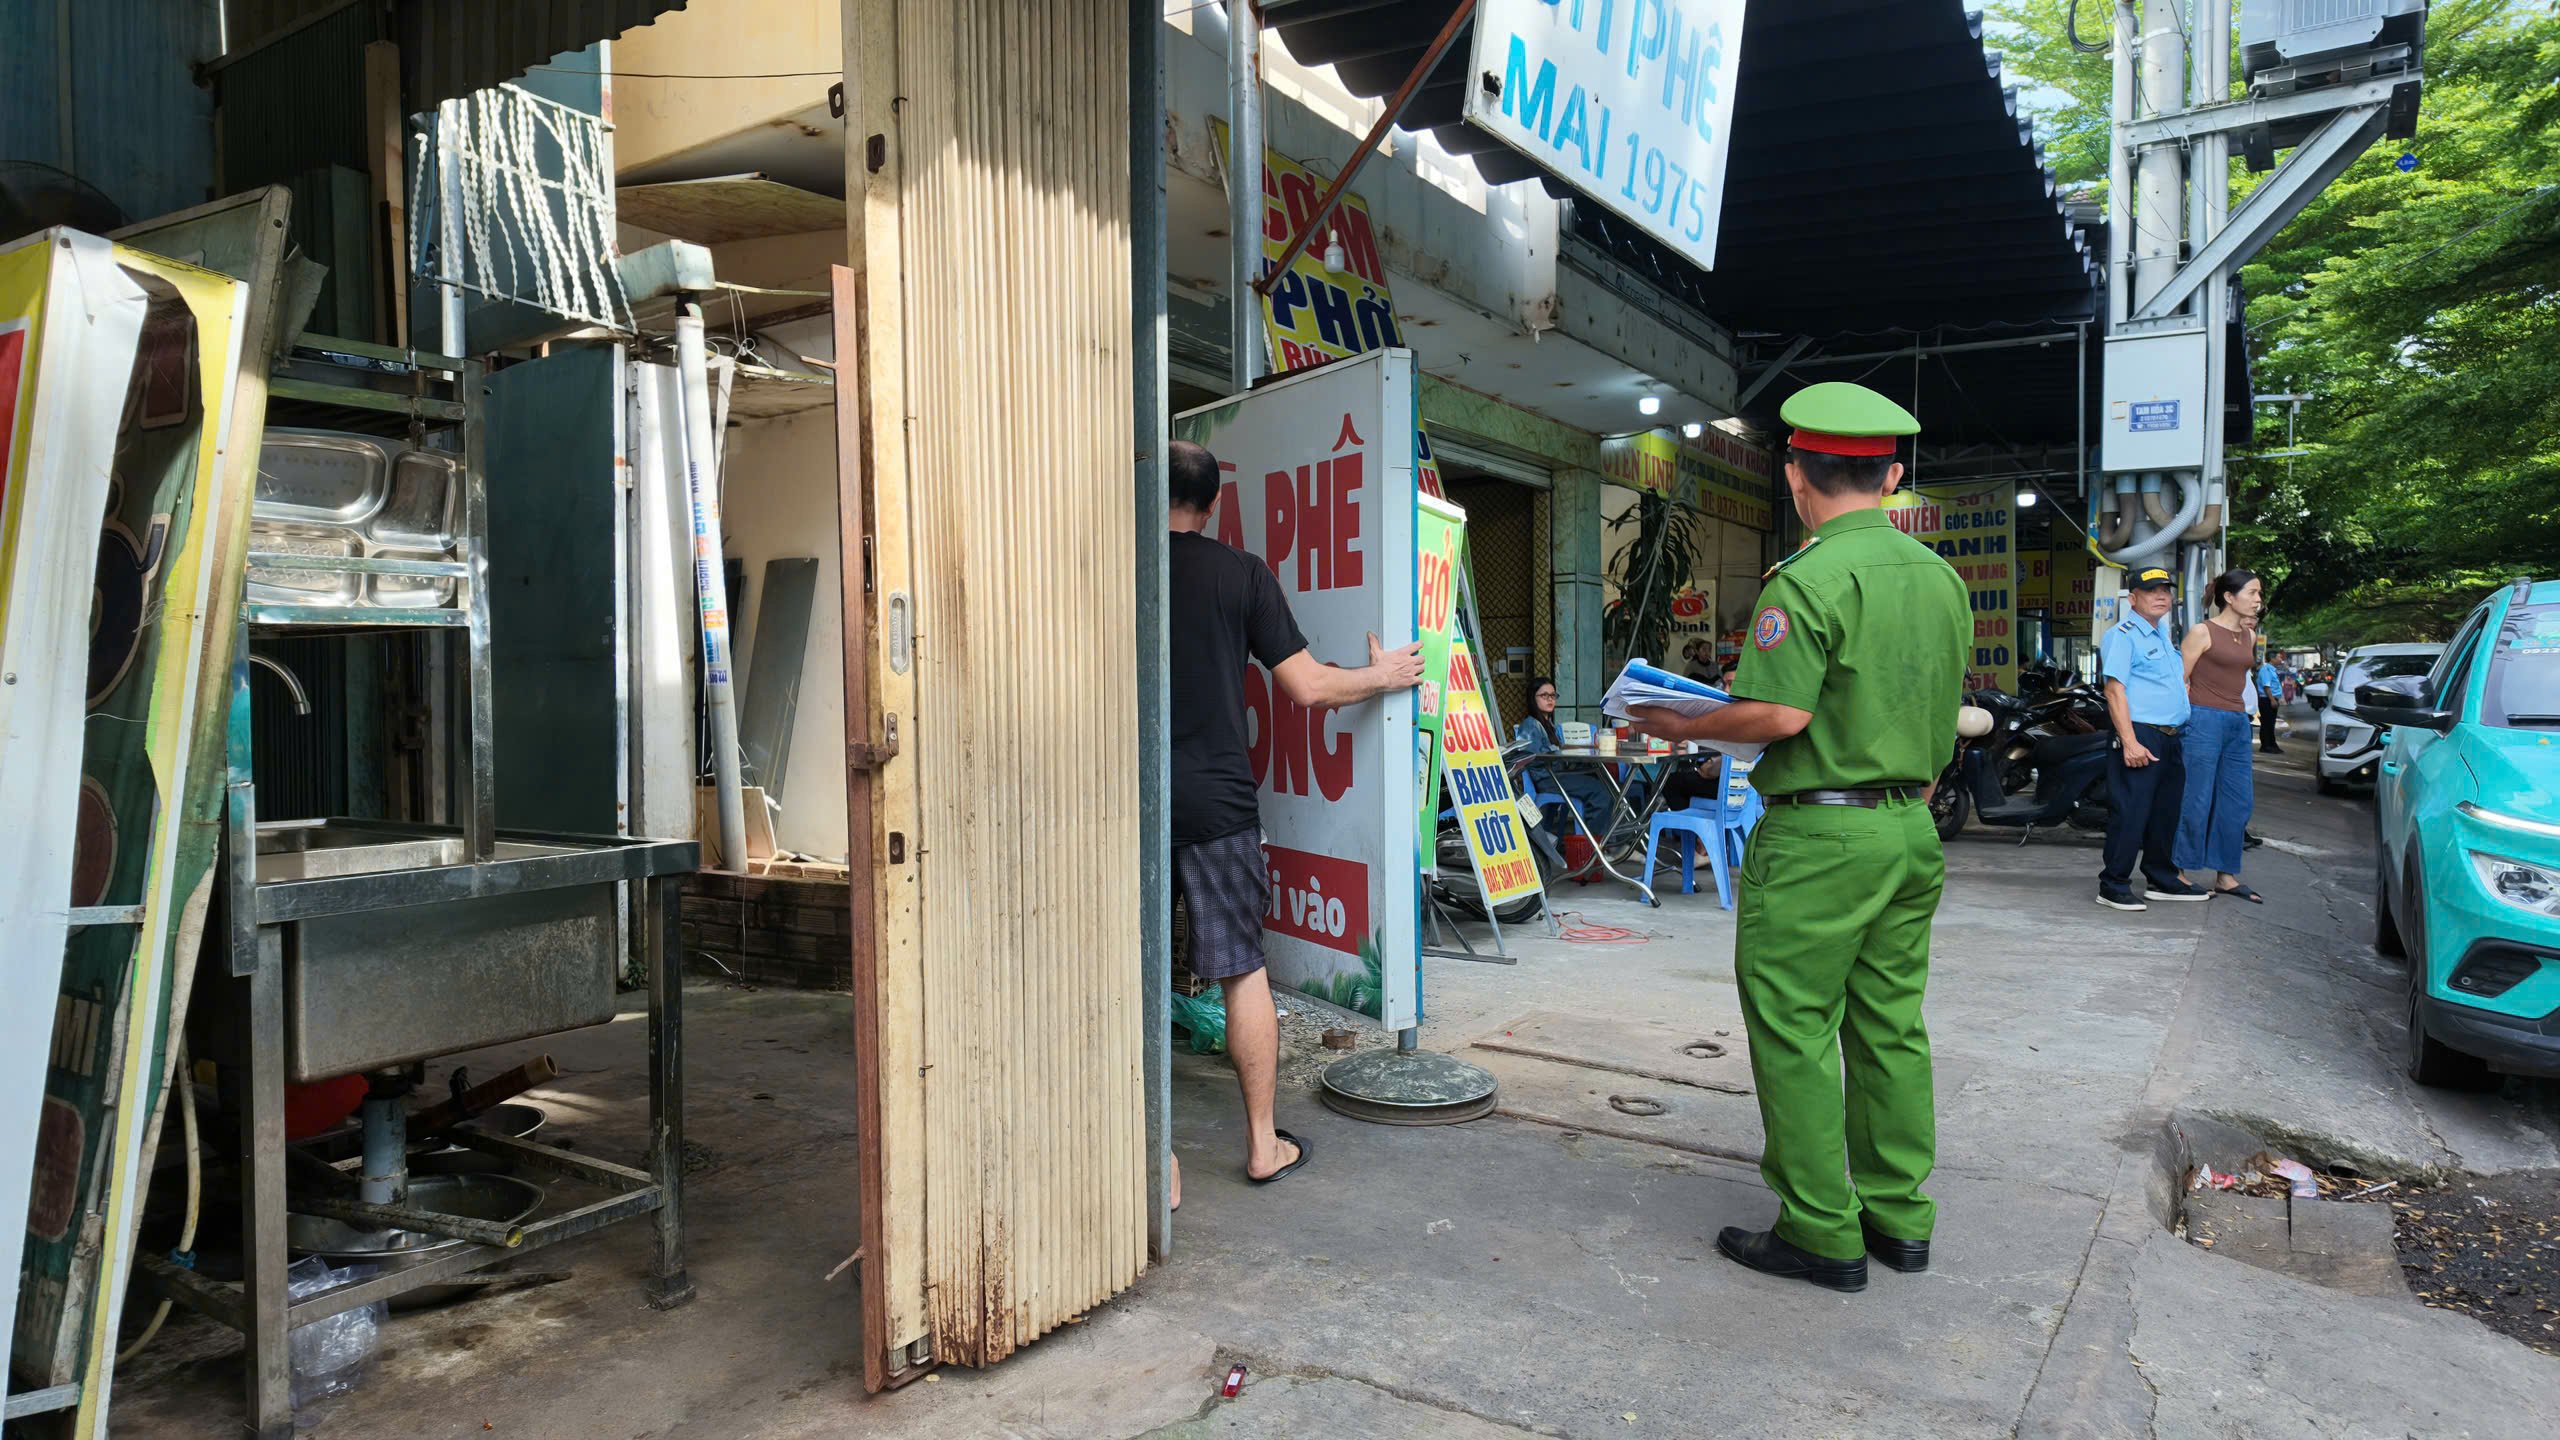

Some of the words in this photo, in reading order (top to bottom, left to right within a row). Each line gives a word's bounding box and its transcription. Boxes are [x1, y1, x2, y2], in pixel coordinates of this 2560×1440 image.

[1502, 32, 1610, 180] MAI
[1621, 131, 1708, 242] 1975
[1265, 413, 1364, 592] PHÊ
[1886, 497, 1941, 534] RUYỀN
[1418, 526, 1454, 633] HỞ
[1451, 762, 1509, 805] BÁNH
[1475, 810, 1516, 856] ƯỚT
[1288, 875, 1346, 938] vào
